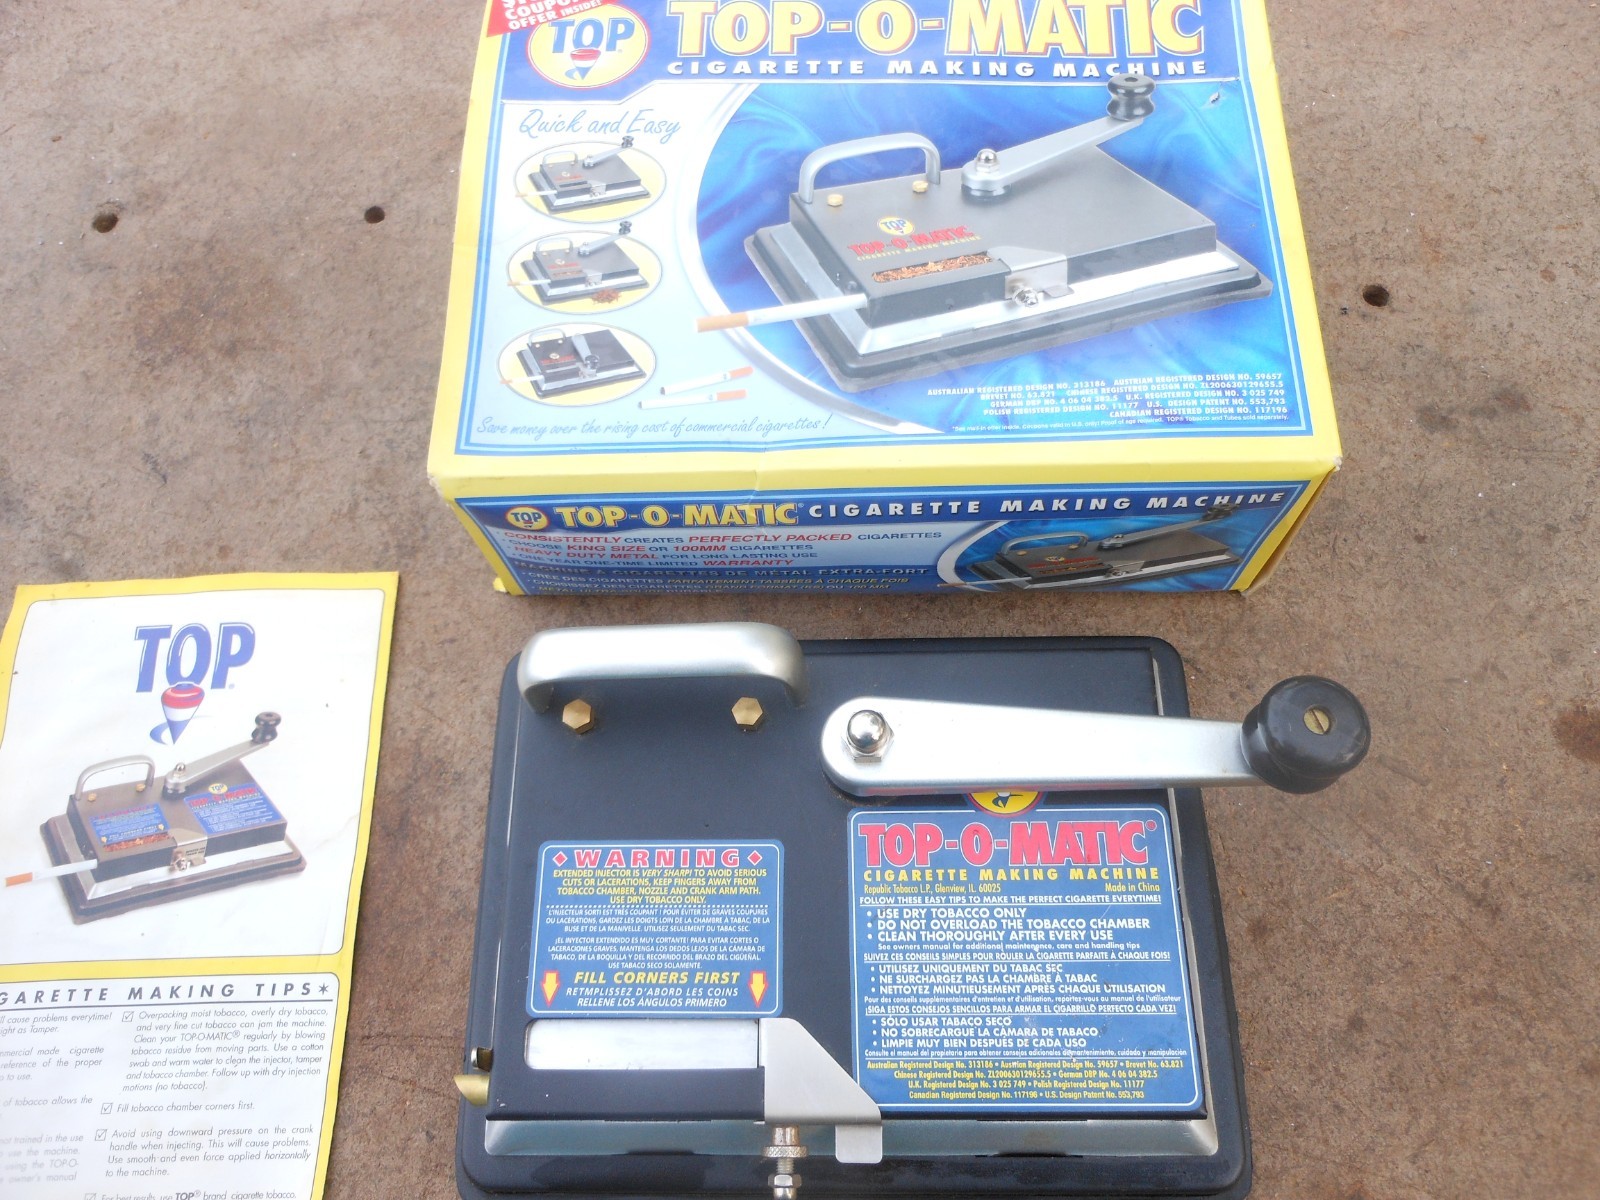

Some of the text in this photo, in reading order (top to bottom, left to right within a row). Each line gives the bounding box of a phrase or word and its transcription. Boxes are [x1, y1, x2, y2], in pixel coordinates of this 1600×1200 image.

[508, 11, 558, 30] OFFER
[666, 0, 1204, 57] TOP-O-MATIC
[549, 18, 635, 53] TOP
[667, 60, 1207, 76] CIGARETTE MAKING MACHINE
[519, 109, 680, 144] Quick and Easy
[1206, 375, 1235, 383] DESIGN
[477, 416, 507, 434] Save
[510, 424, 547, 441] money
[550, 425, 577, 434] over
[581, 418, 600, 433] the
[603, 421, 639, 438] rising
[641, 421, 668, 433] cost
[670, 417, 687, 438] of
[686, 416, 757, 432] commercial
[555, 492, 1285, 528] TOP-O-MATIC CIGARETTE MAKING MACHINE
[510, 511, 543, 524] TOP
[504, 532, 621, 543] CONSISTENTLY
[689, 534, 781, 543] PERFECTLY
[786, 532, 852, 542] PACKED
[857, 532, 942, 541] CIGARETTES
[134, 622, 256, 693] TOP
[858, 820, 1149, 867] TOP-O-MATIC
[573, 849, 741, 868] WARNING
[553, 868, 767, 877] EXTENDED INJECTOR IS VERY SHARP! TO AVOID SERIOUS
[863, 867, 1159, 881] CIGARETTE MAKING MACHINE
[562, 878, 582, 886] CUTS
[584, 878, 595, 886] OR
[597, 878, 651, 886] LACERATIONS,
[674, 878, 706, 886] FINGERS
[708, 878, 732, 886] AWAY
[733, 878, 756, 886] FROM
[1105, 882, 1160, 892] Made in China
[558, 886, 760, 895] TOBACCO CHAMBER, NOZZLE AND CRANK ARM PATH.
[610, 896, 706, 904] USE DRY TOBACCO ONLY.
[877, 907, 1026, 920] USE DRY TOBACCO ONLY
[878, 918, 1150, 930] DO NOT OVERLOAD THE TOBACCO CHAMBER
[878, 930, 1113, 942] CLEAN THOROUGHLY AFTER EVERY USE
[879, 963, 1063, 974] UTILISEZ UNIQUEMENT DU TABAC SEC
[574, 971, 740, 984] FILL CORNERS FIRST
[127, 984, 235, 1000] MAKING
[139, 1007, 328, 1020] Overpacking moist tobacco, overly dry tobacco,
[136, 1022, 152, 1032] and
[155, 1024, 172, 1032] very
[174, 1021, 188, 1030] fine
[205, 1020, 237, 1029] tobacco
[257, 1021, 273, 1030] jam
[276, 1019, 289, 1027] the
[291, 1019, 327, 1027] machine.
[116, 1103, 129, 1112] Fill
[131, 1103, 164, 1112] tobacco
[166, 1102, 202, 1111] chamber
[237, 1100, 256, 1110] first.
[116, 1167, 129, 1177] the
[131, 1166, 170, 1176] machine.
